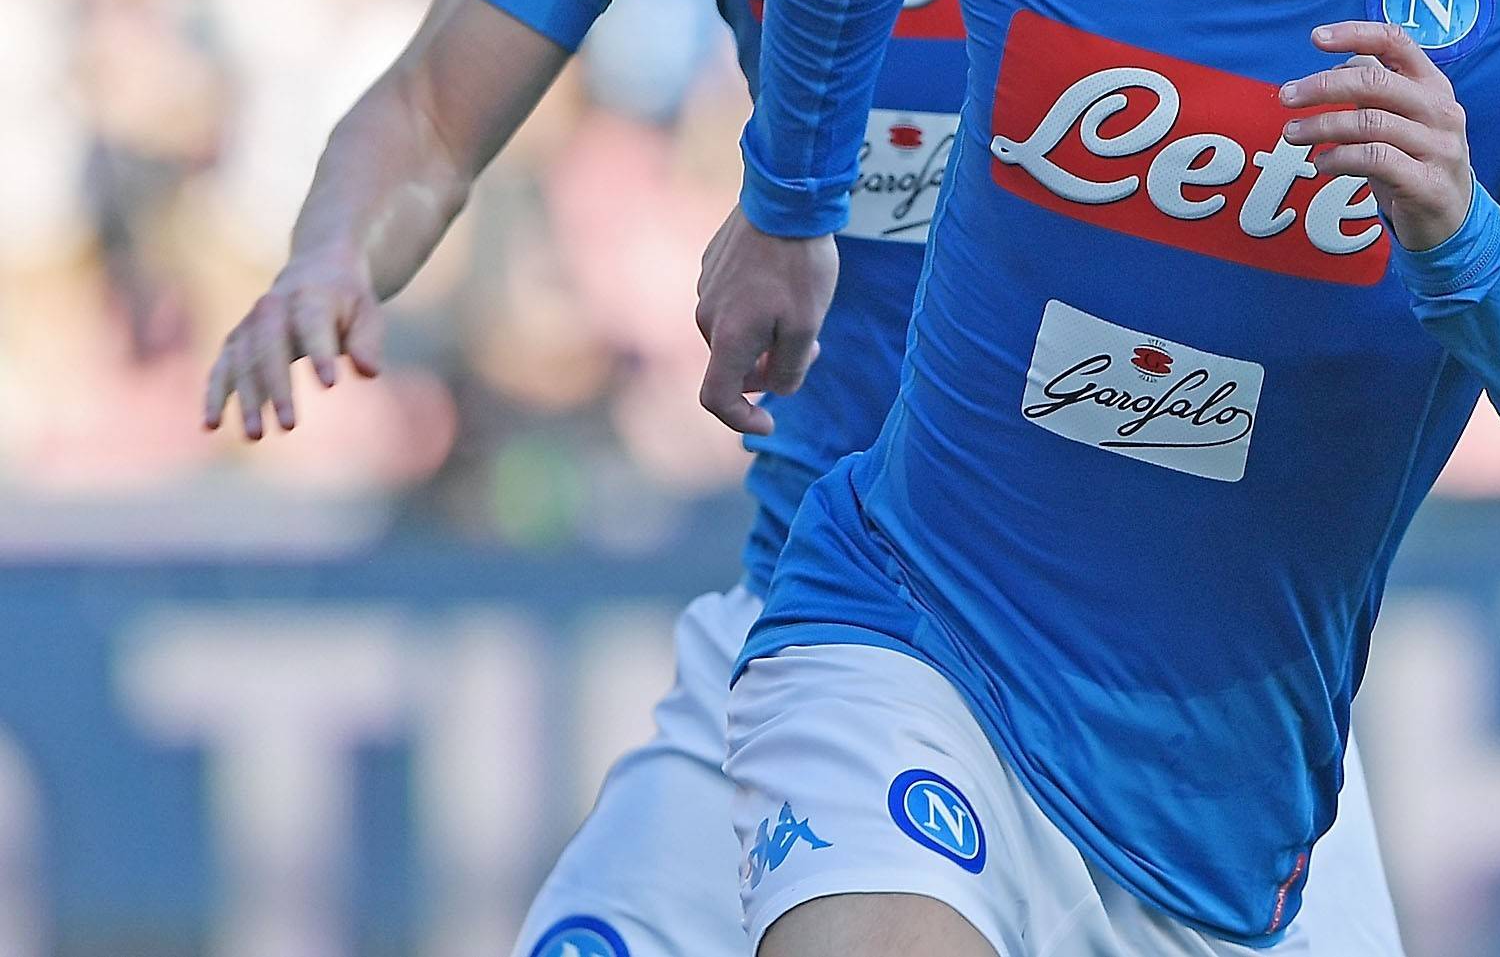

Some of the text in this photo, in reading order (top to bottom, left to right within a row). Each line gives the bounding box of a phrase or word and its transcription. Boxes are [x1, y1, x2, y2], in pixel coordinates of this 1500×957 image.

[991, 67, 1383, 254] Lete
[1024, 354, 1253, 446] Garofalo
[923, 788, 966, 847] N
